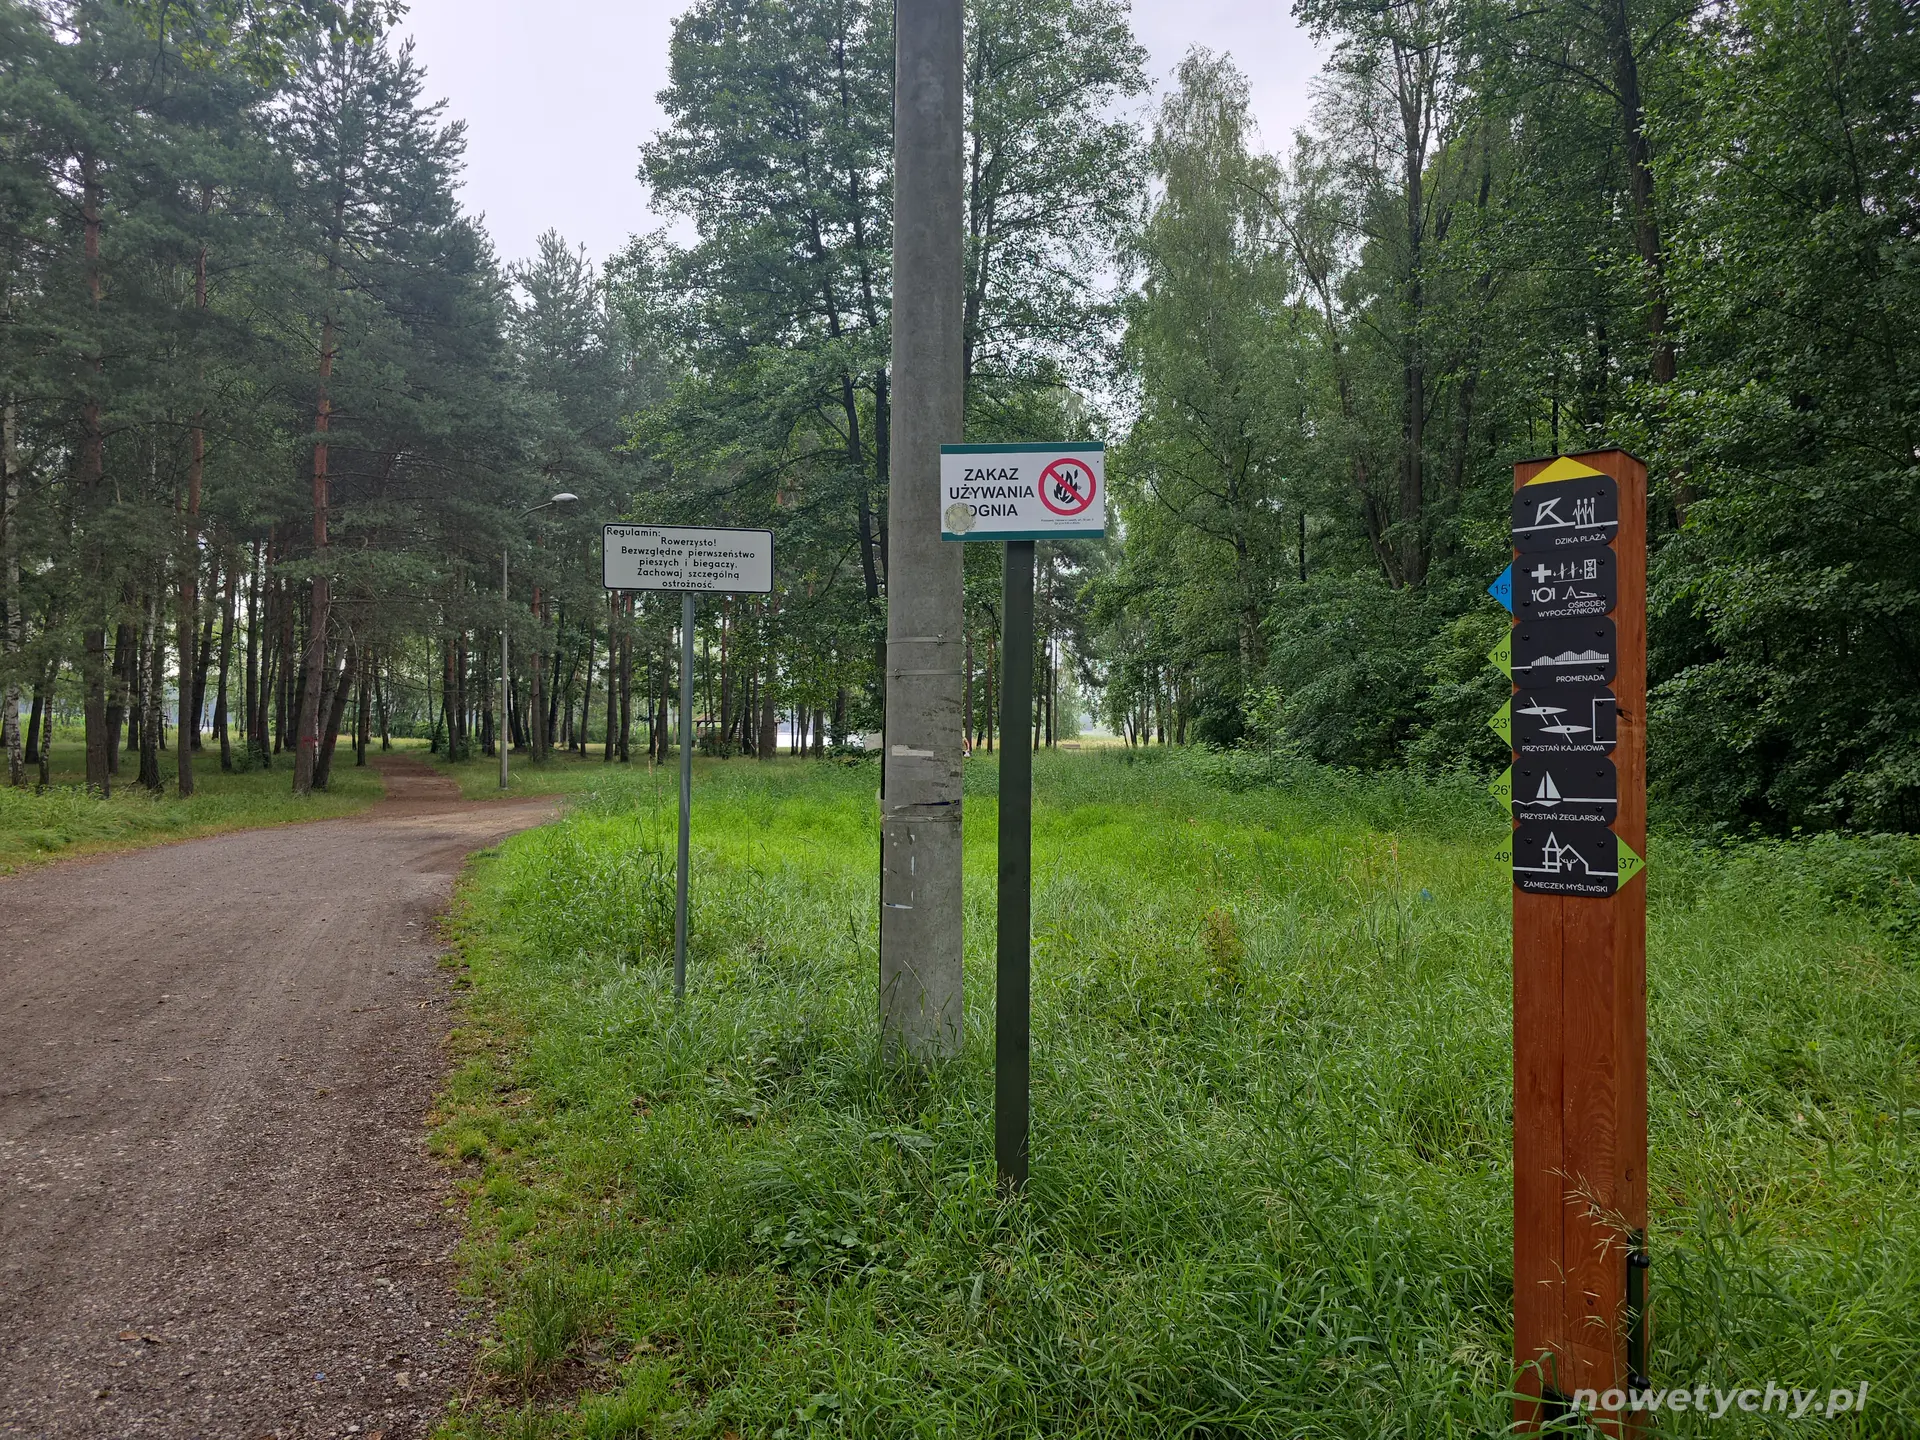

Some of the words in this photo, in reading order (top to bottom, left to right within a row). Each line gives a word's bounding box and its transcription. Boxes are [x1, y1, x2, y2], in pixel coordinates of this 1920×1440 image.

[964, 468, 1018, 481] ZAKAZ
[950, 484, 1034, 499] UŻYWANIA
[607, 527, 660, 537] Regulamin:
[661, 537, 716, 548] Rowerzysto!
[1580, 533, 1606, 542] PLAŻA
[621, 546, 682, 557] Bezwzględne
[688, 550, 755, 559] pierwszeństwo
[640, 559, 679, 567] pieszych
[694, 560, 737, 569] biegaczy.
[637, 568, 683, 578] Zachowaj
[688, 570, 740, 580] szczególną
[662, 580, 714, 589] ostrożność.
[1568, 599, 1605, 608] OŚRODEK
[1538, 607, 1605, 617] WYPOCZYNKOWY
[1522, 744, 1559, 752] PRZYSTAŃ
[1520, 813, 1557, 821] PRZYSTAŃ
[1559, 813, 1605, 822] ŻEGLARSKA
[1524, 881, 1564, 890] ZAMECZEK
[1566, 883, 1608, 893] MYŚLIWSKI
